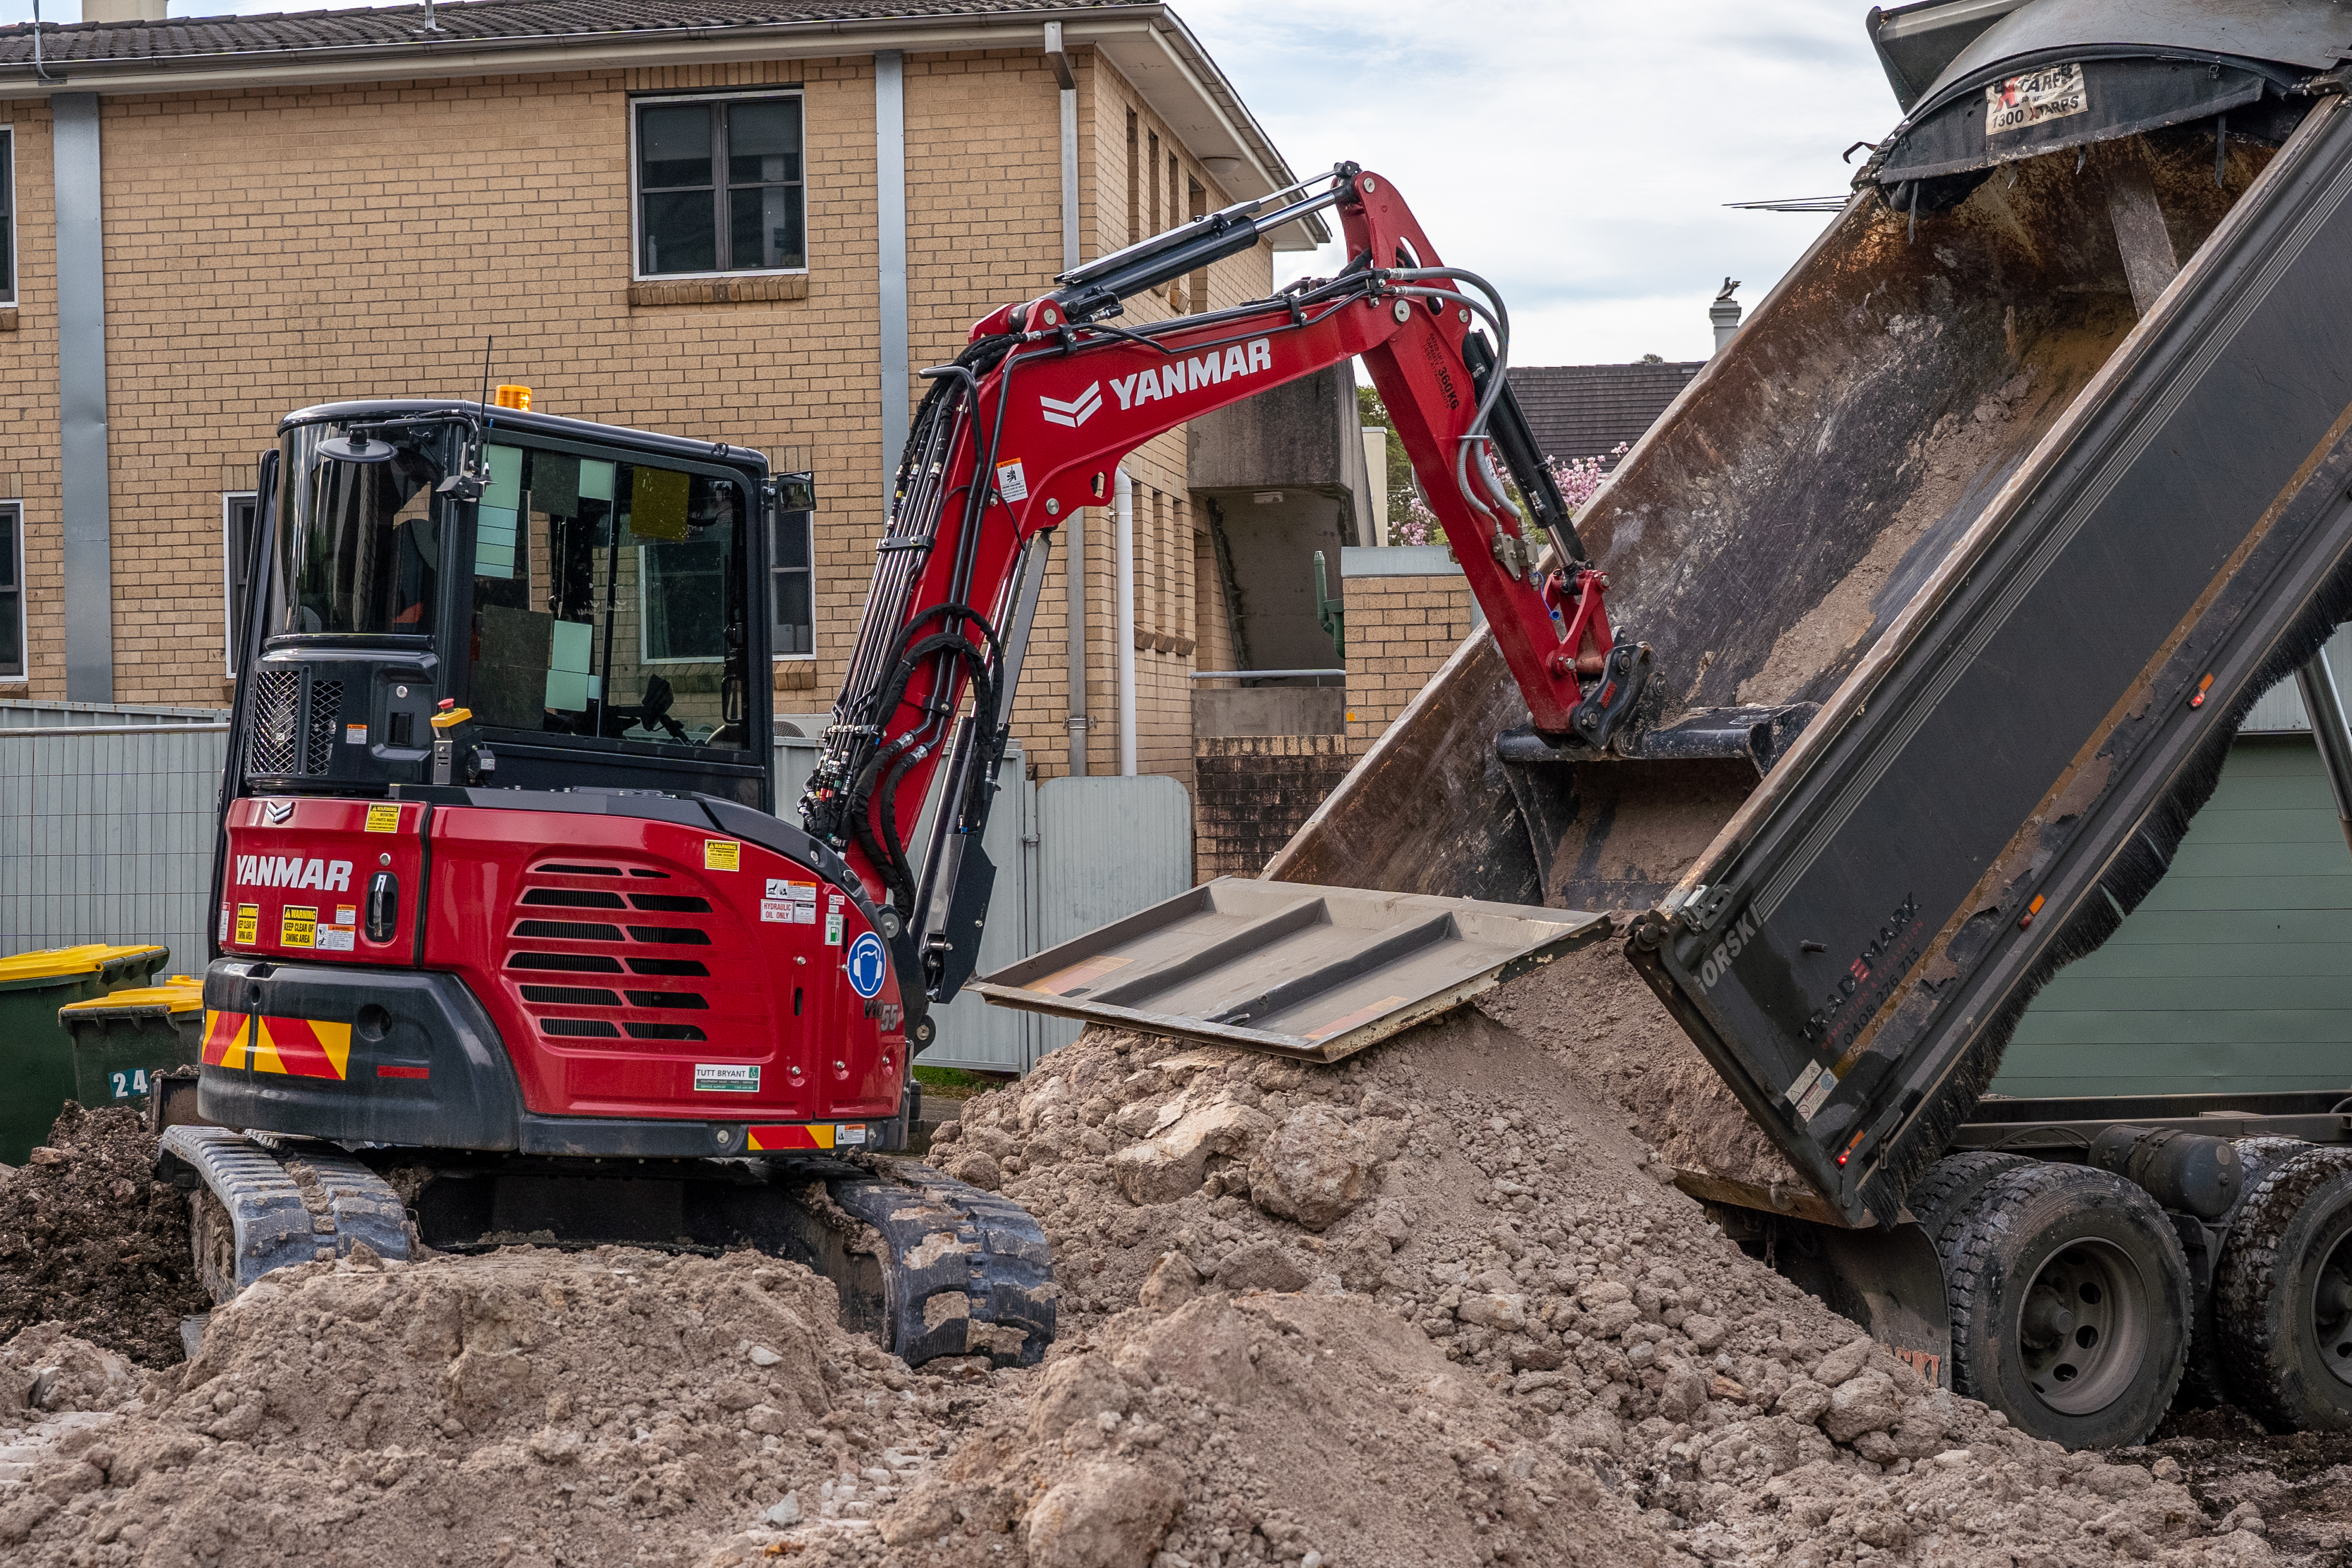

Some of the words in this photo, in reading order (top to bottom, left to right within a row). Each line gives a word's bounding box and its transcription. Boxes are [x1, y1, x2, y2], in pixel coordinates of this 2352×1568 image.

[1992, 109, 2024, 128] 1300
[2028, 95, 2080, 121] XTARPS
[1109, 338, 1271, 411] YANMAR
[1438, 366, 1459, 411] 360KG
[236, 855, 353, 892] YANMAR
[242, 907, 258, 917] WARNING
[291, 909, 316, 920] WARNING
[764, 902, 791, 911] HYDRAULIC
[284, 922, 294, 932] KEEP
[295, 923, 307, 932] CLEAR
[308, 924, 314, 932] OF
[285, 933, 298, 942] SWING
[299, 934, 310, 944] AREA
[1797, 891, 1922, 1045] TRADEMARK
[1822, 991, 1869, 1051] DEMOLITION
[1877, 921, 1923, 978] EXCAVATION
[1843, 1003, 1876, 1045] 0408
[1875, 973, 1899, 1005] 276
[1897, 947, 1919, 975] 713
